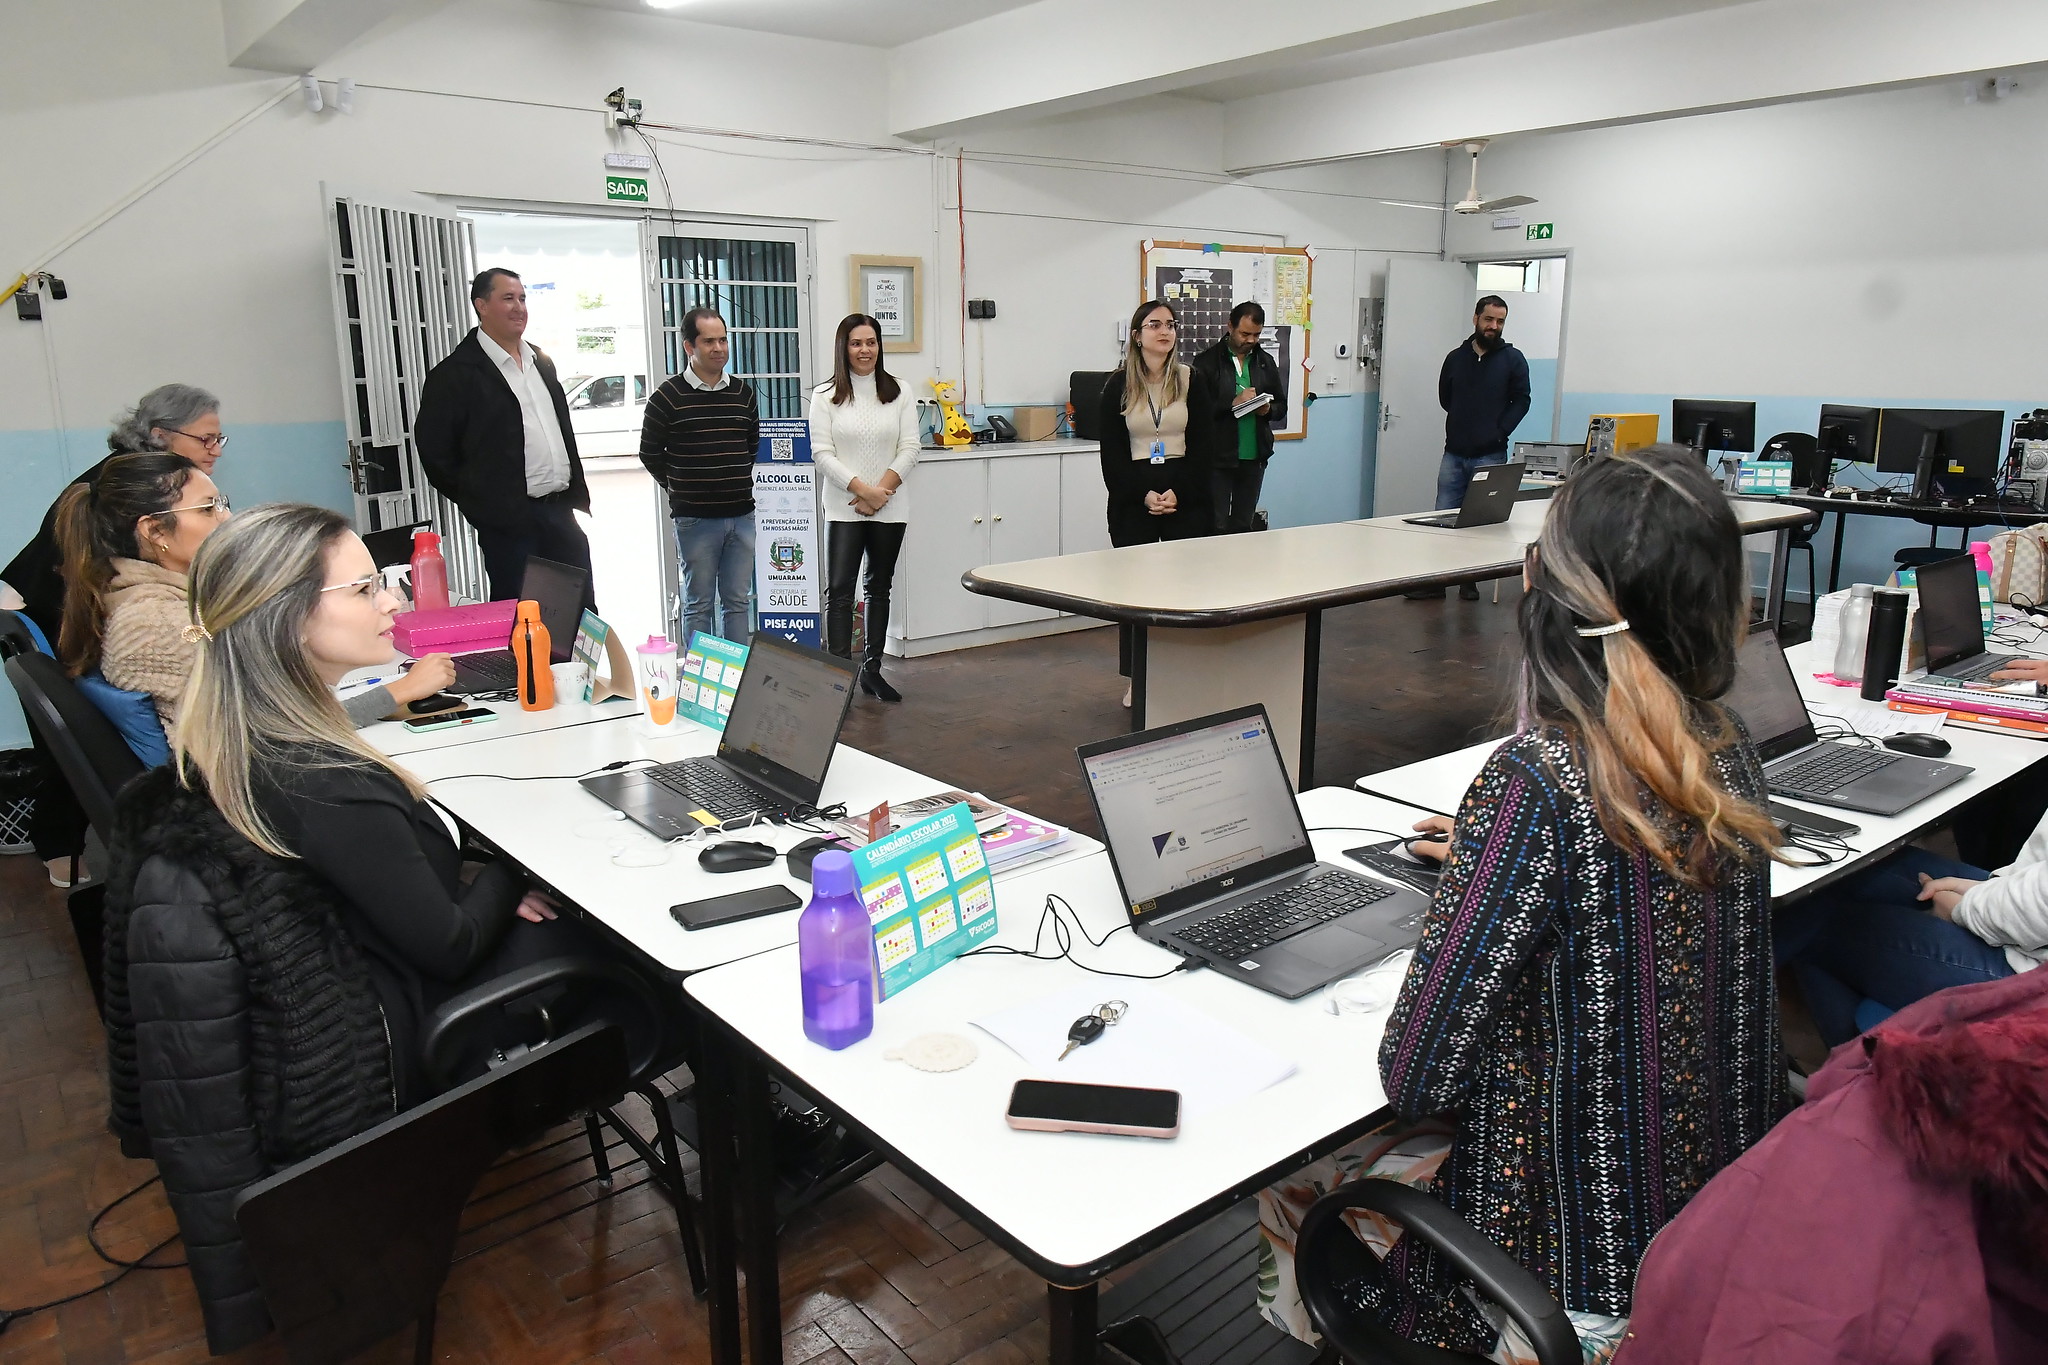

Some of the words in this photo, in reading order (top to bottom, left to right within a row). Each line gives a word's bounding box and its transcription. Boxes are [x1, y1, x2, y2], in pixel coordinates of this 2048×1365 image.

[607, 180, 648, 197] SAÍDA
[756, 471, 792, 483] ÁLCOOL
[794, 475, 811, 483] GEL
[769, 594, 808, 606] SAÚDE
[764, 619, 787, 629] PISE
[789, 619, 814, 631] AQUI
[866, 835, 911, 861] CALENDÁRIO
[911, 820, 941, 842] ESCOLAR
[942, 813, 957, 828] 2022
[1220, 877, 1235, 887] acer
[975, 917, 995, 934] SICOOB
